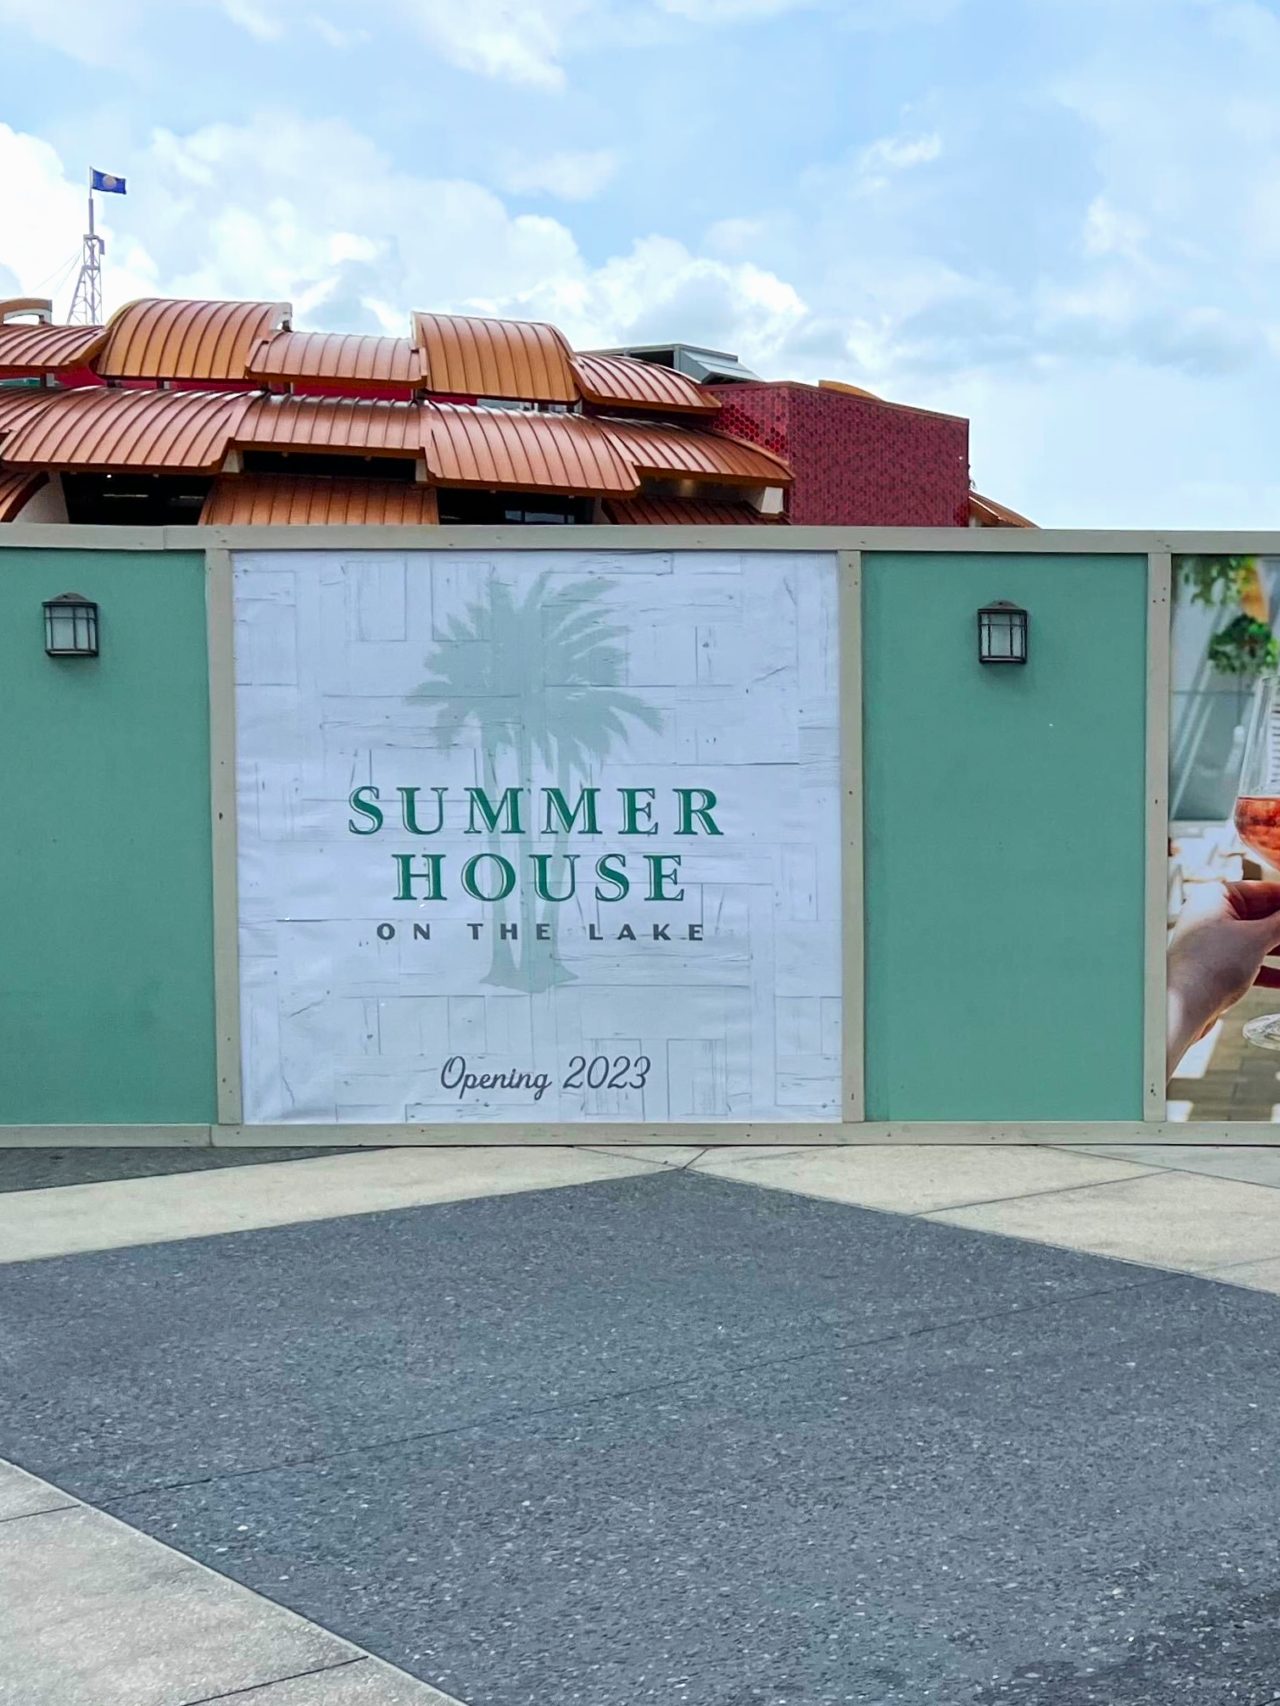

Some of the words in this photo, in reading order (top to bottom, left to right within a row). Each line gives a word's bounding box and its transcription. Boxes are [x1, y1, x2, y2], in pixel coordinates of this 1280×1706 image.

[347, 785, 725, 836] SUMMER
[391, 852, 686, 903] HOUSE
[376, 922, 432, 941] ON
[467, 922, 552, 941] THE
[588, 923, 705, 942] LAKE
[440, 1054, 553, 1101] Opening
[561, 1054, 652, 1090] 2023
